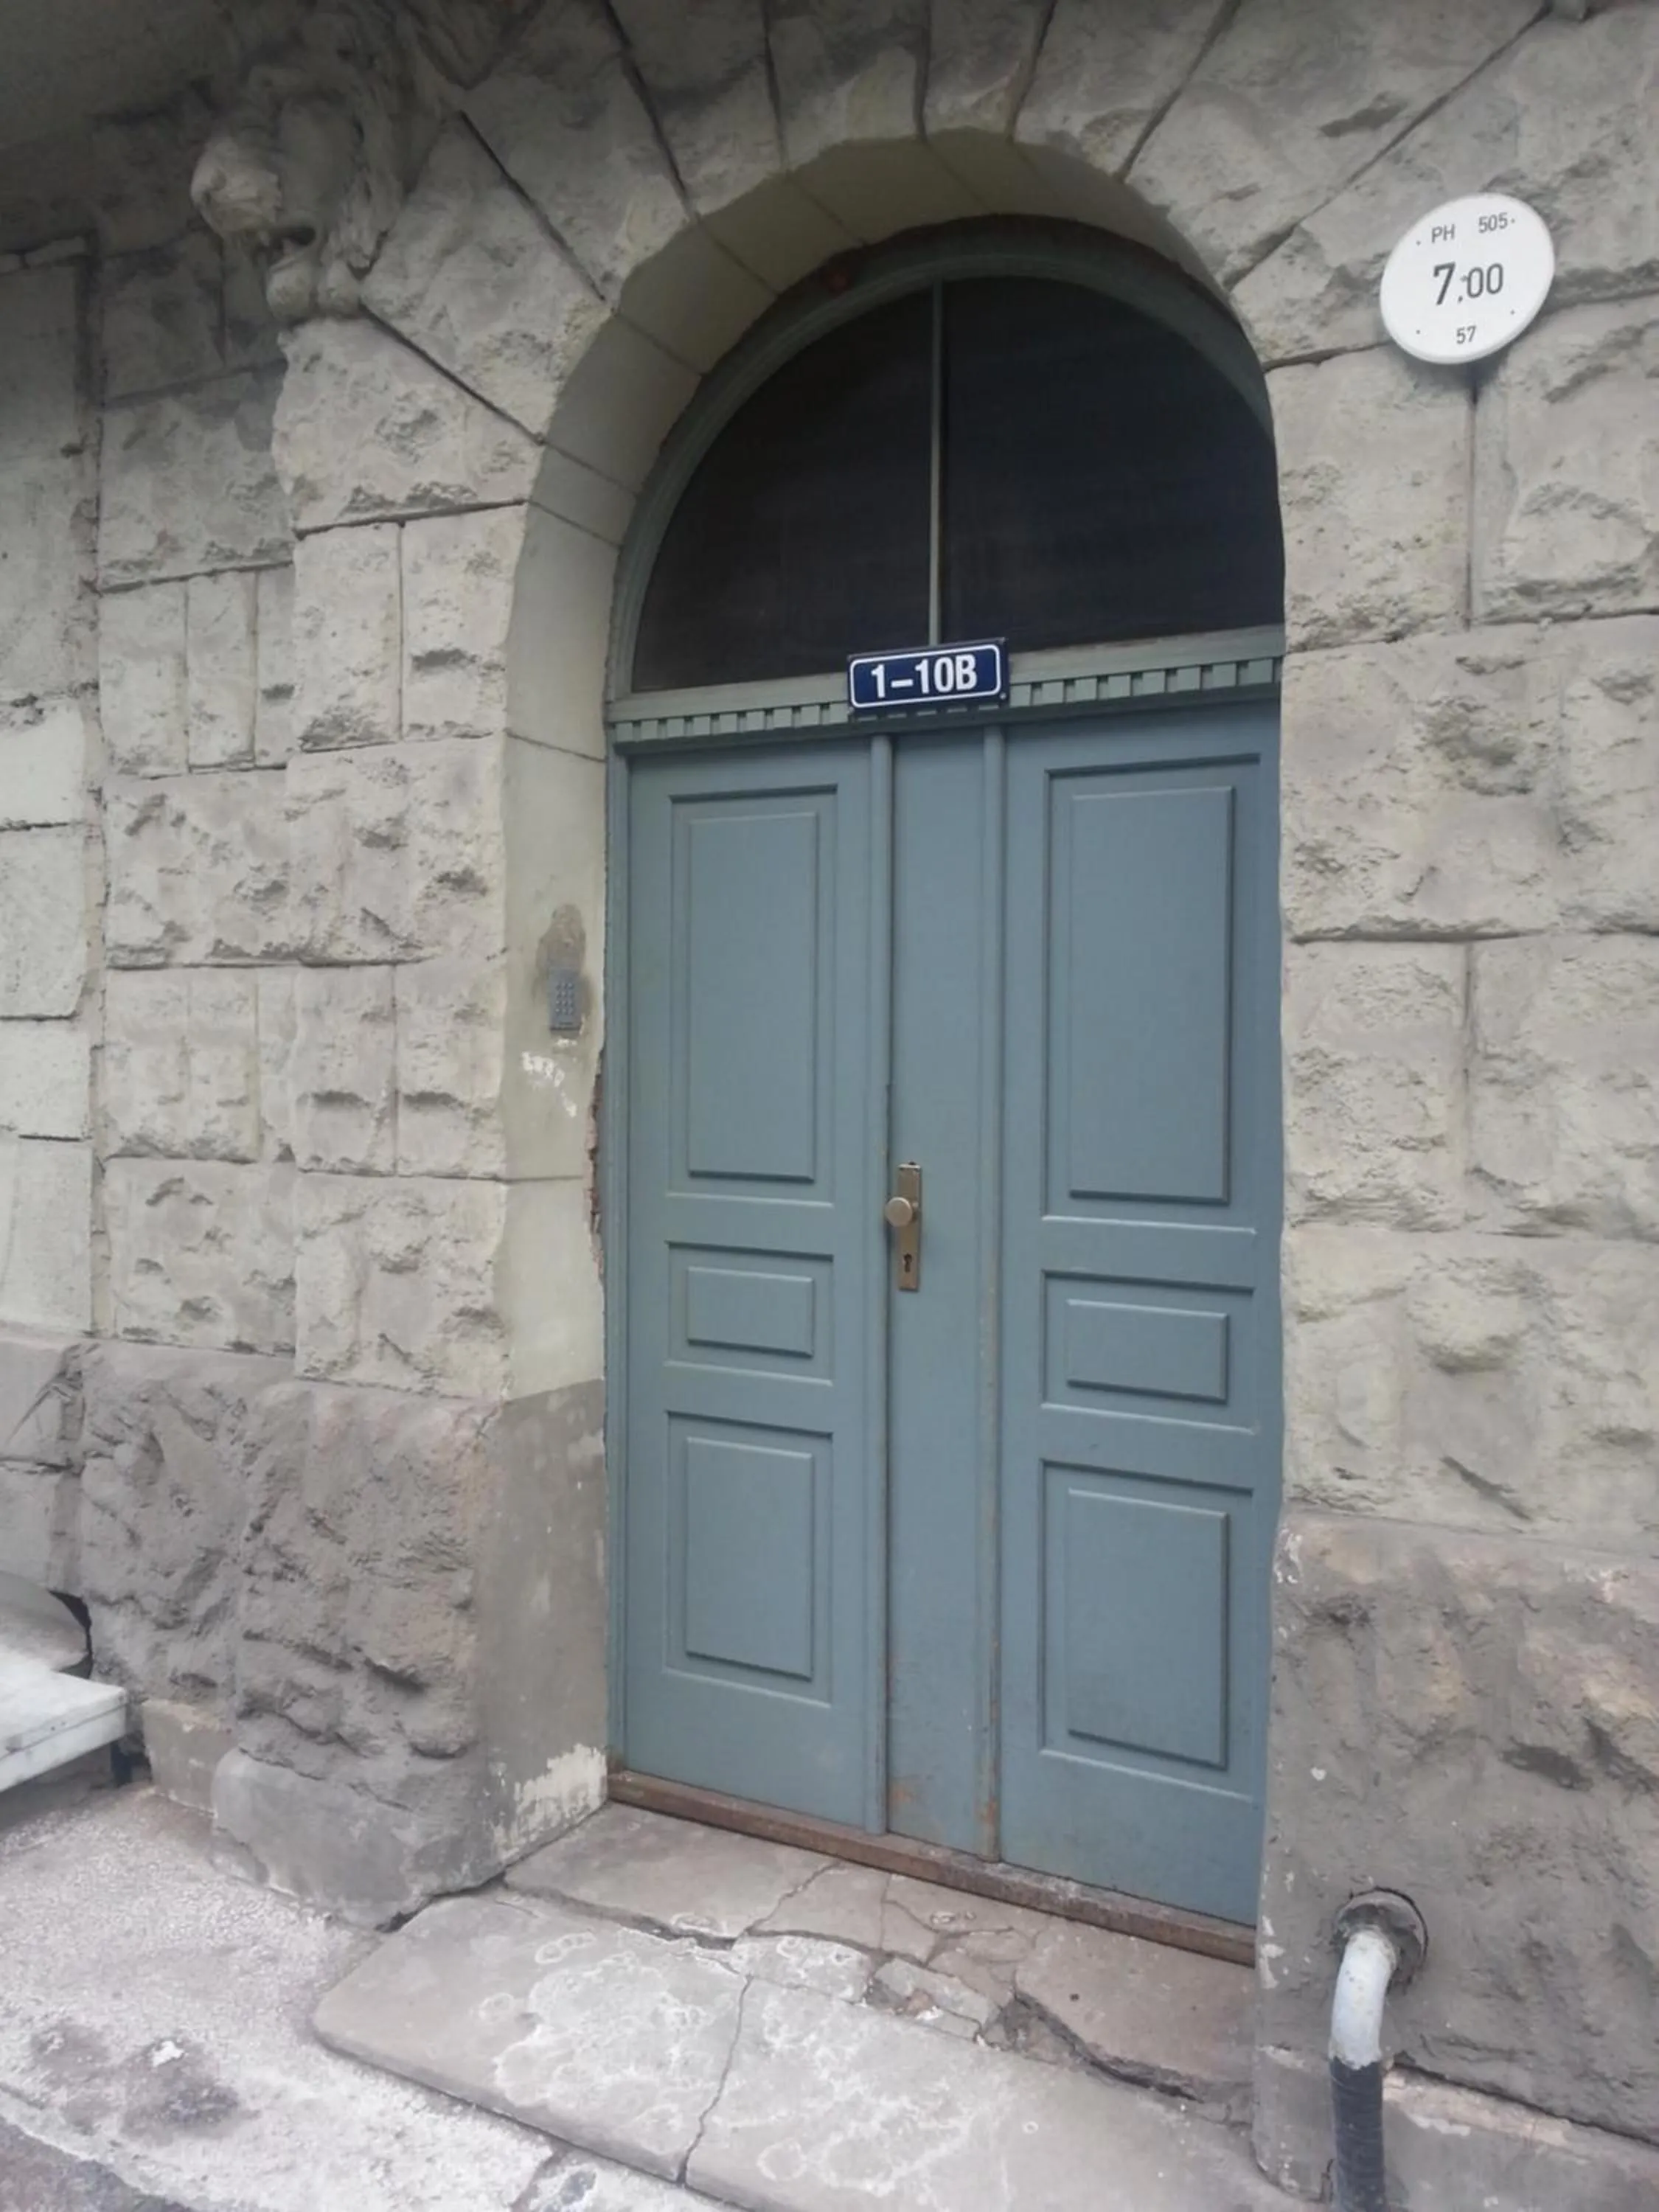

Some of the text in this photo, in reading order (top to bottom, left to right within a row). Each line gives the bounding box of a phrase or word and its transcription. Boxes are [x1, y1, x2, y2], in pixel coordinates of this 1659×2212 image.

[1431, 212, 1509, 244] PH 505
[1455, 325, 1477, 344] 57
